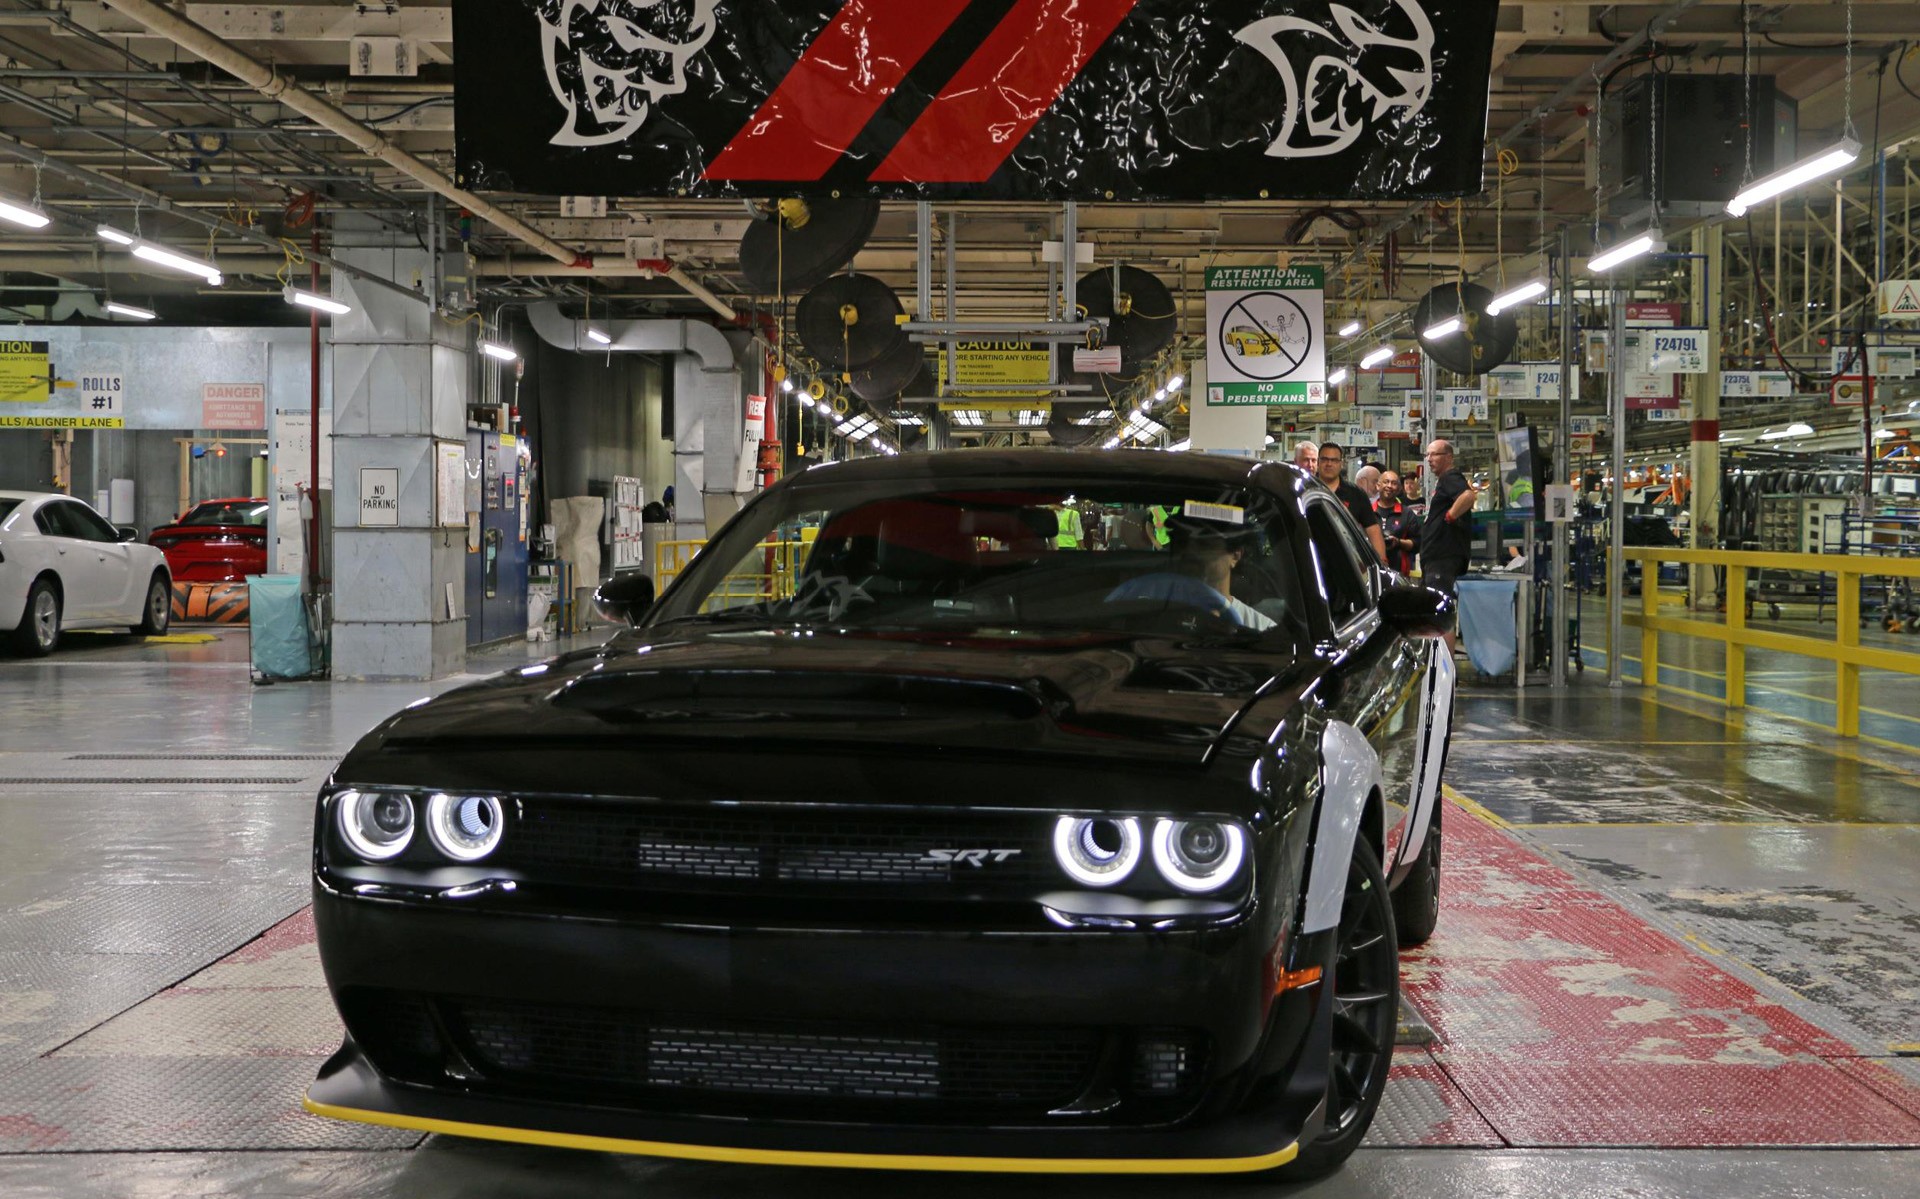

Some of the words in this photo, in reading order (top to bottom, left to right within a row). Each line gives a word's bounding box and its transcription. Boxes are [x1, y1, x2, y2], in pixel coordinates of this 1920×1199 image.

[1210, 279, 1282, 288] RESTRICTED
[1284, 278, 1315, 286] AREA
[956, 341, 1031, 350] CAUTION
[1655, 337, 1698, 351] F2479L
[83, 378, 121, 392] ROLLS
[207, 387, 260, 398] DANGER
[92, 396, 112, 409] #1
[1227, 394, 1305, 404] PEDESTRIANS
[0, 417, 77, 427] LLS/ALIGNER
[82, 418, 112, 427] LANE
[118, 418, 122, 427] 1
[374, 485, 385, 495] NO
[363, 500, 396, 509] PARKING
[920, 849, 1022, 867] SRT
